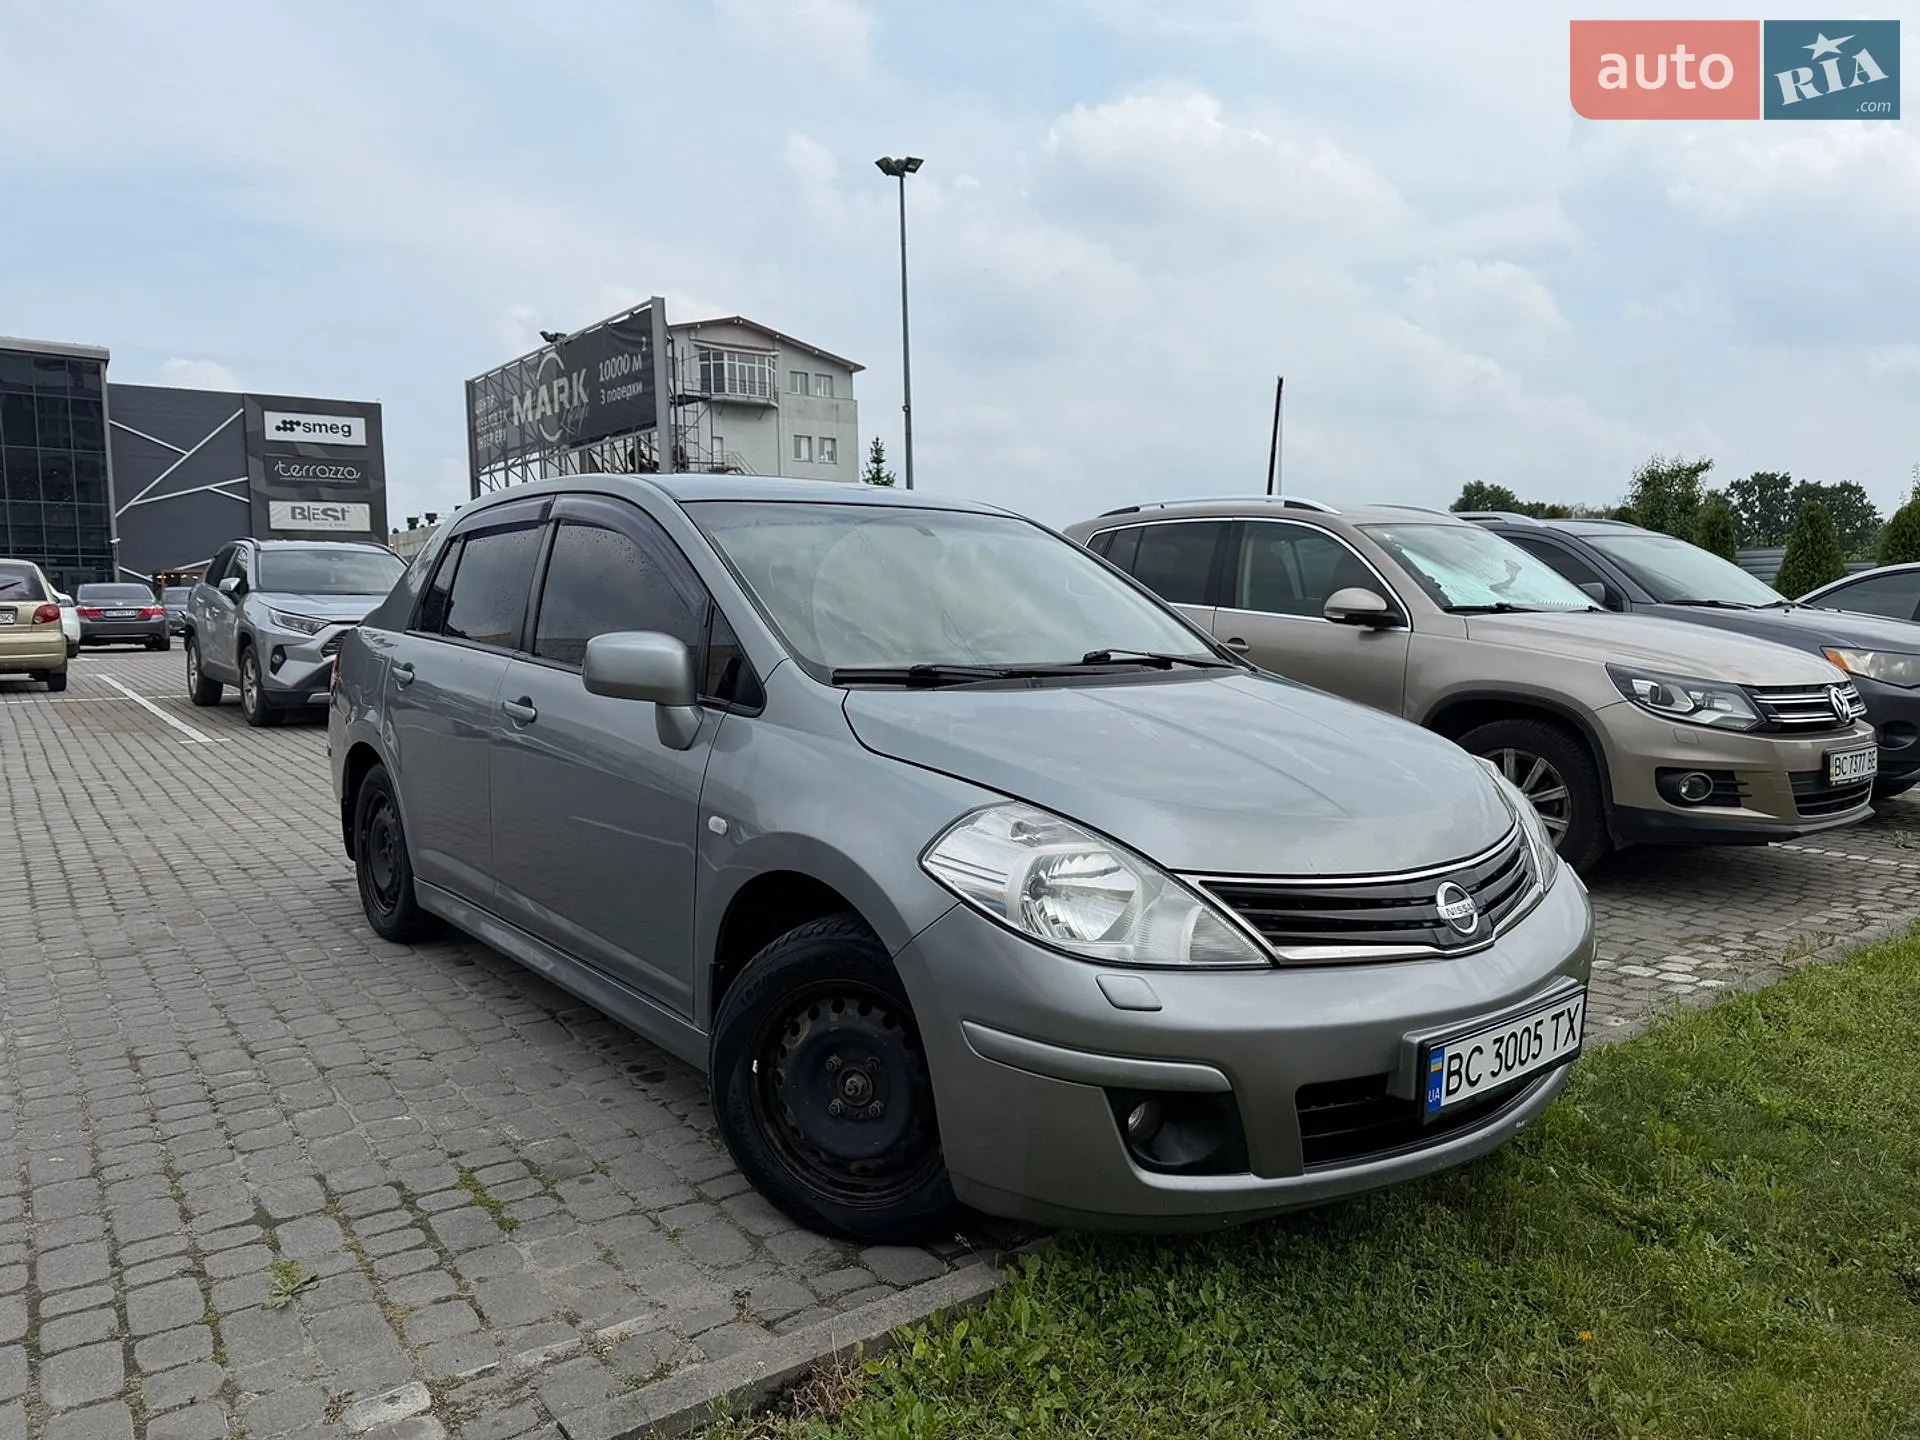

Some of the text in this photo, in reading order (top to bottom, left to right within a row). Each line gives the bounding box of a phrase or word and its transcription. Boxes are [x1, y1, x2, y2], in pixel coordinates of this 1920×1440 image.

[599, 353, 631, 382] 10000
[512, 368, 589, 426] MARK
[600, 388, 606, 405] 3
[302, 422, 352, 438] smeg
[1445, 902, 1476, 917] NISSAN
[1446, 1003, 1580, 1097] BC 3005 TX
[1428, 1087, 1440, 1103] UA
